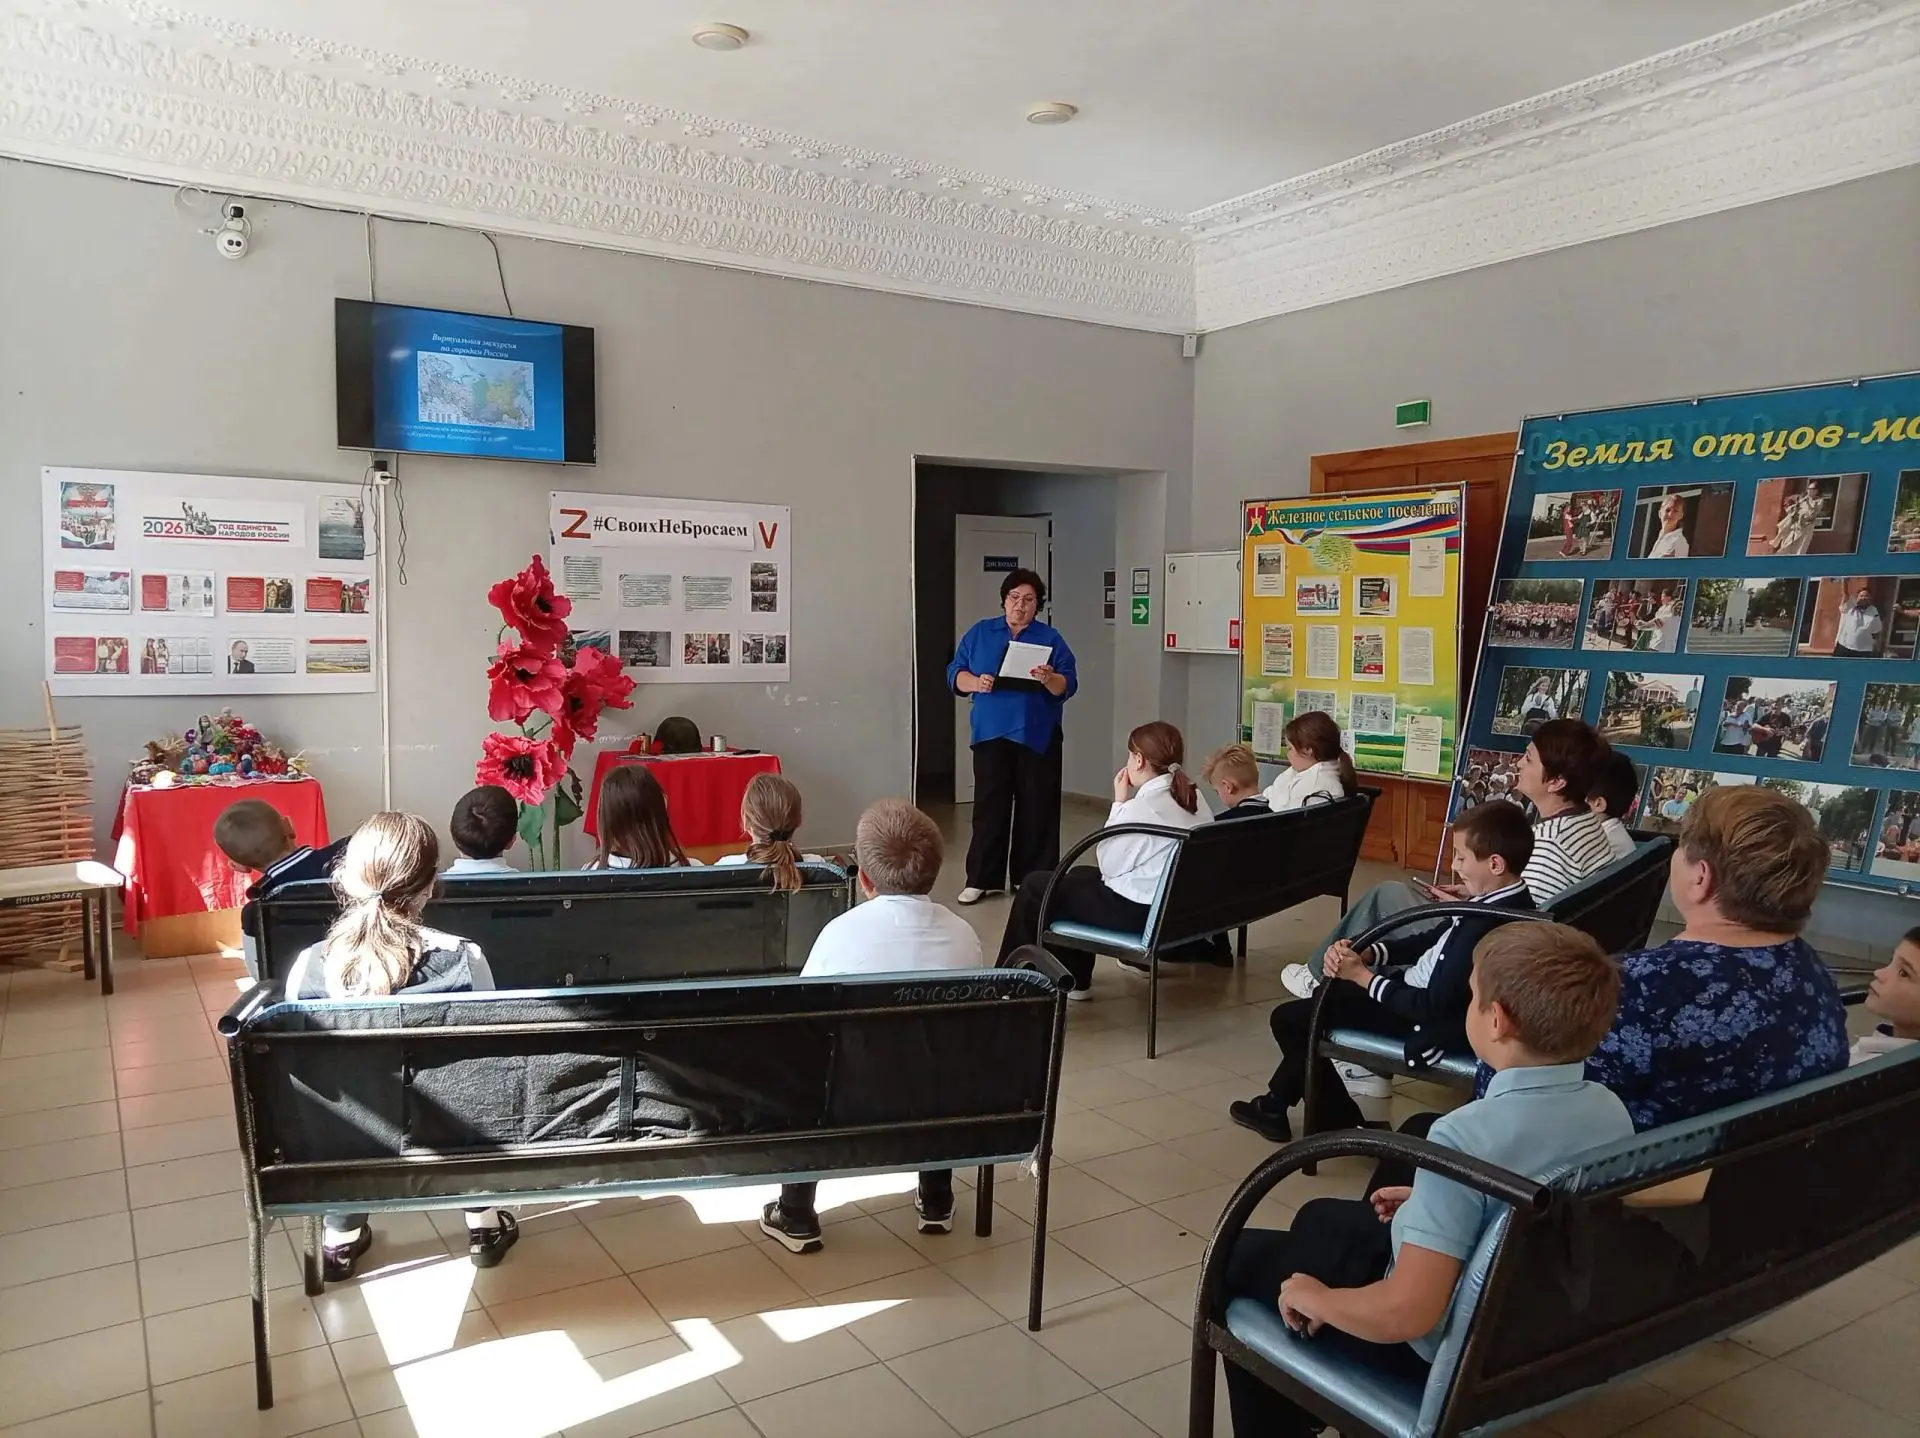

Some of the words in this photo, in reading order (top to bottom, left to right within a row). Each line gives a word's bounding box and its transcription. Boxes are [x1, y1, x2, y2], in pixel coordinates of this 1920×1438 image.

[431, 332, 481, 346] Виртуальная
[482, 340, 518, 349] экскурсия
[451, 347, 482, 355] городам
[483, 349, 509, 358] России
[1543, 436, 1674, 470] Земля
[1267, 509, 1326, 525] Железное
[1328, 506, 1384, 523] сельское
[1387, 500, 1458, 518] поселение
[143, 520, 184, 534] 2026
[218, 522, 234, 531] ГОД
[236, 523, 278, 532] ЕДИНСТВА
[559, 508, 592, 539] Z
[593, 516, 748, 538] #СвоихНеБросаем
[218, 530, 256, 539] НАРОДОВ
[257, 531, 290, 539] РОССИИ
[758, 521, 779, 549] V
